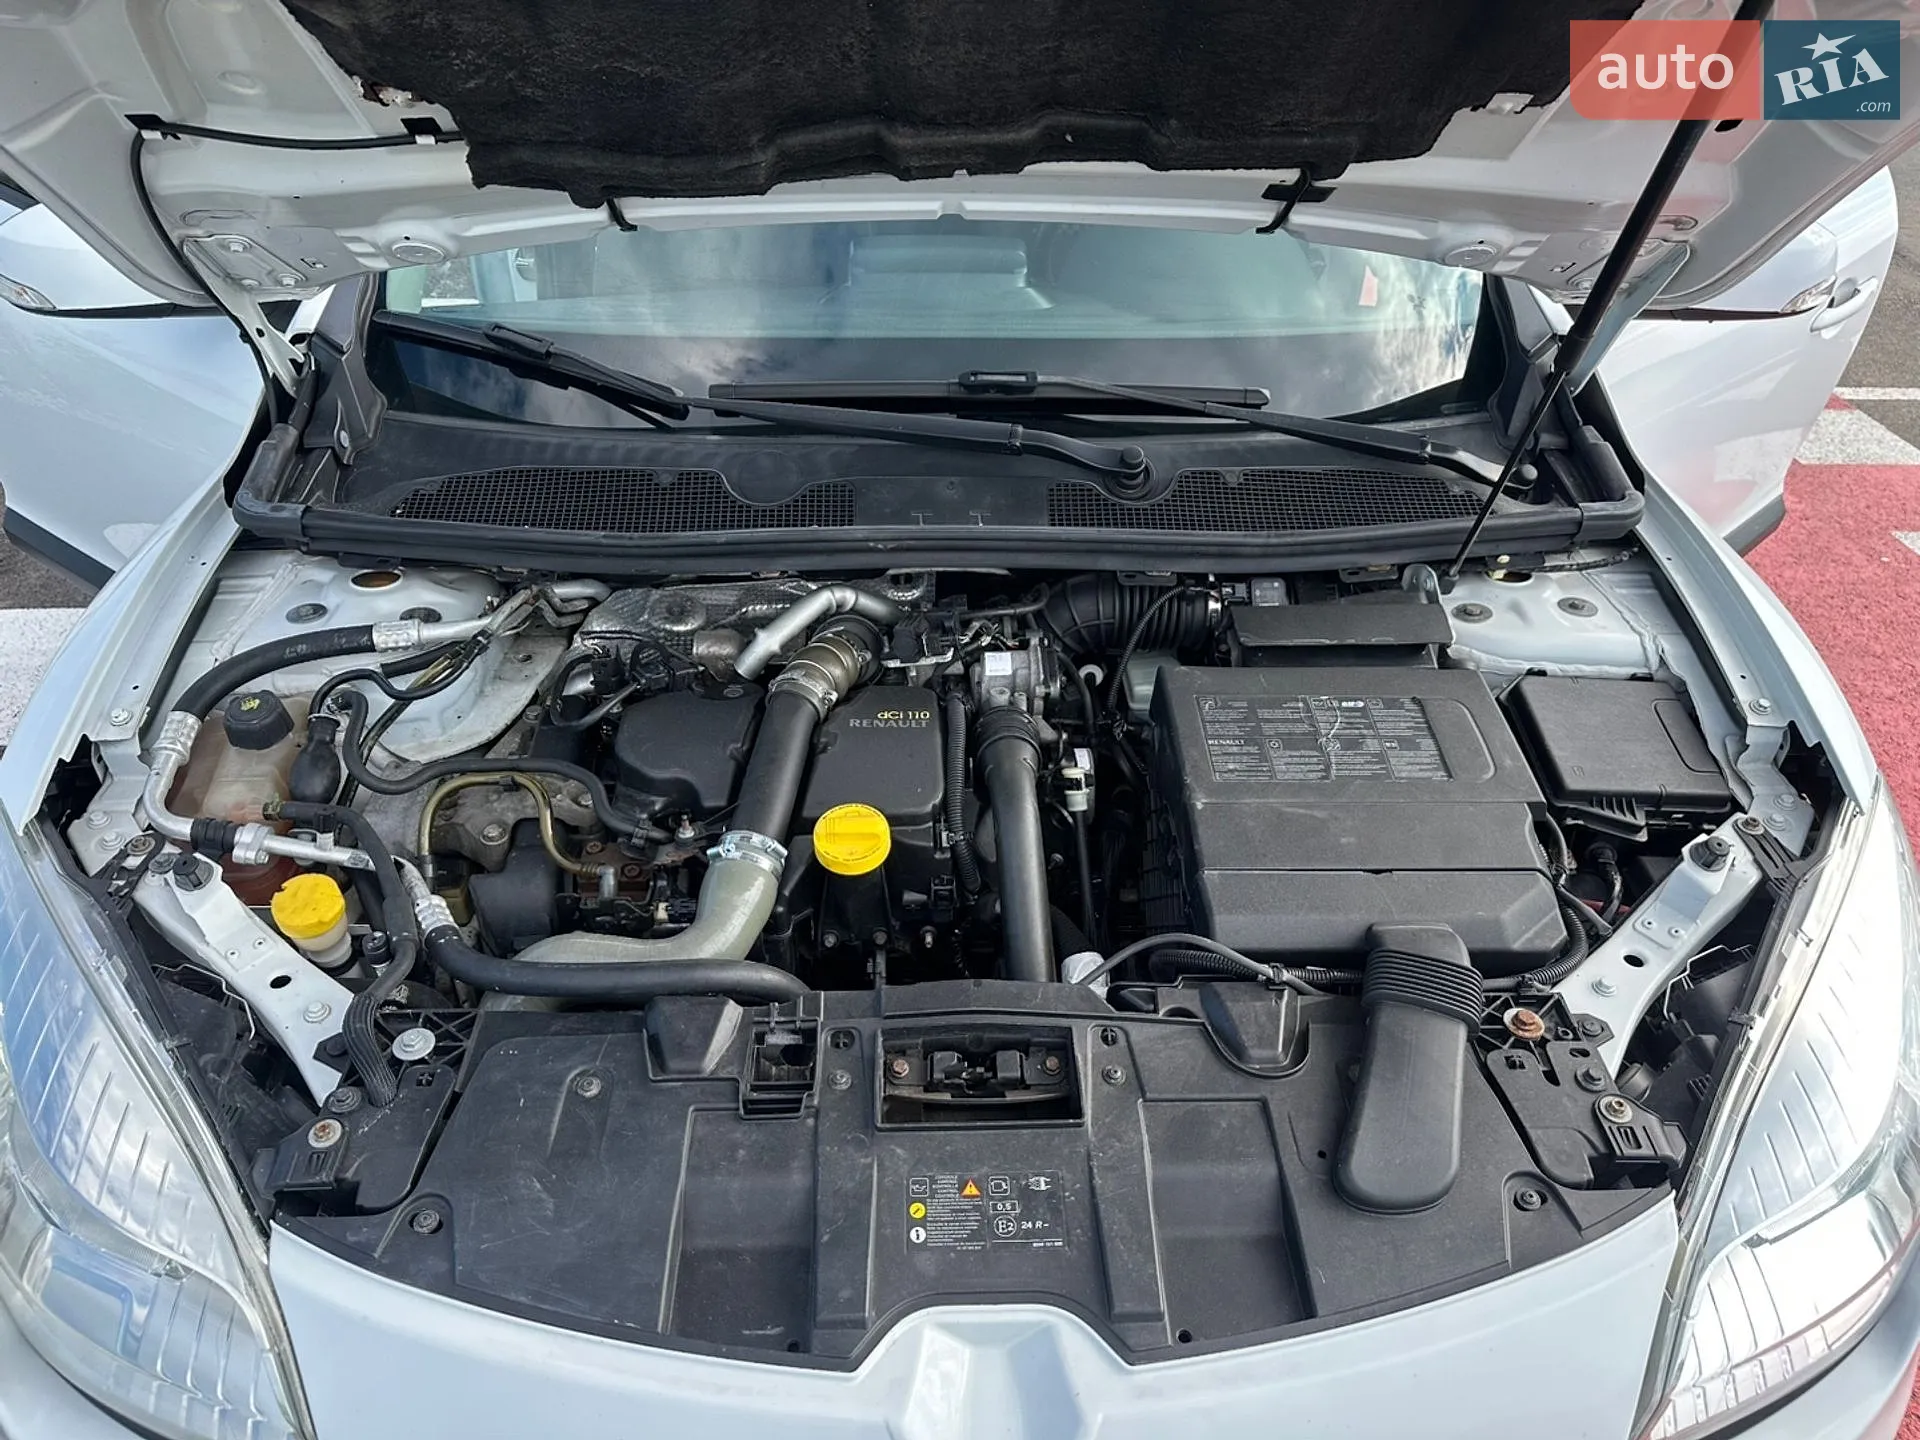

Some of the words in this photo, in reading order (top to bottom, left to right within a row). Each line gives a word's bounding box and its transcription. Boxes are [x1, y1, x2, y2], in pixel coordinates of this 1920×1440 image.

[907, 710, 930, 719] 110
[849, 718, 930, 728] RENAULT
[998, 1220, 1014, 1233] E2
[1021, 1221, 1032, 1229] 24
